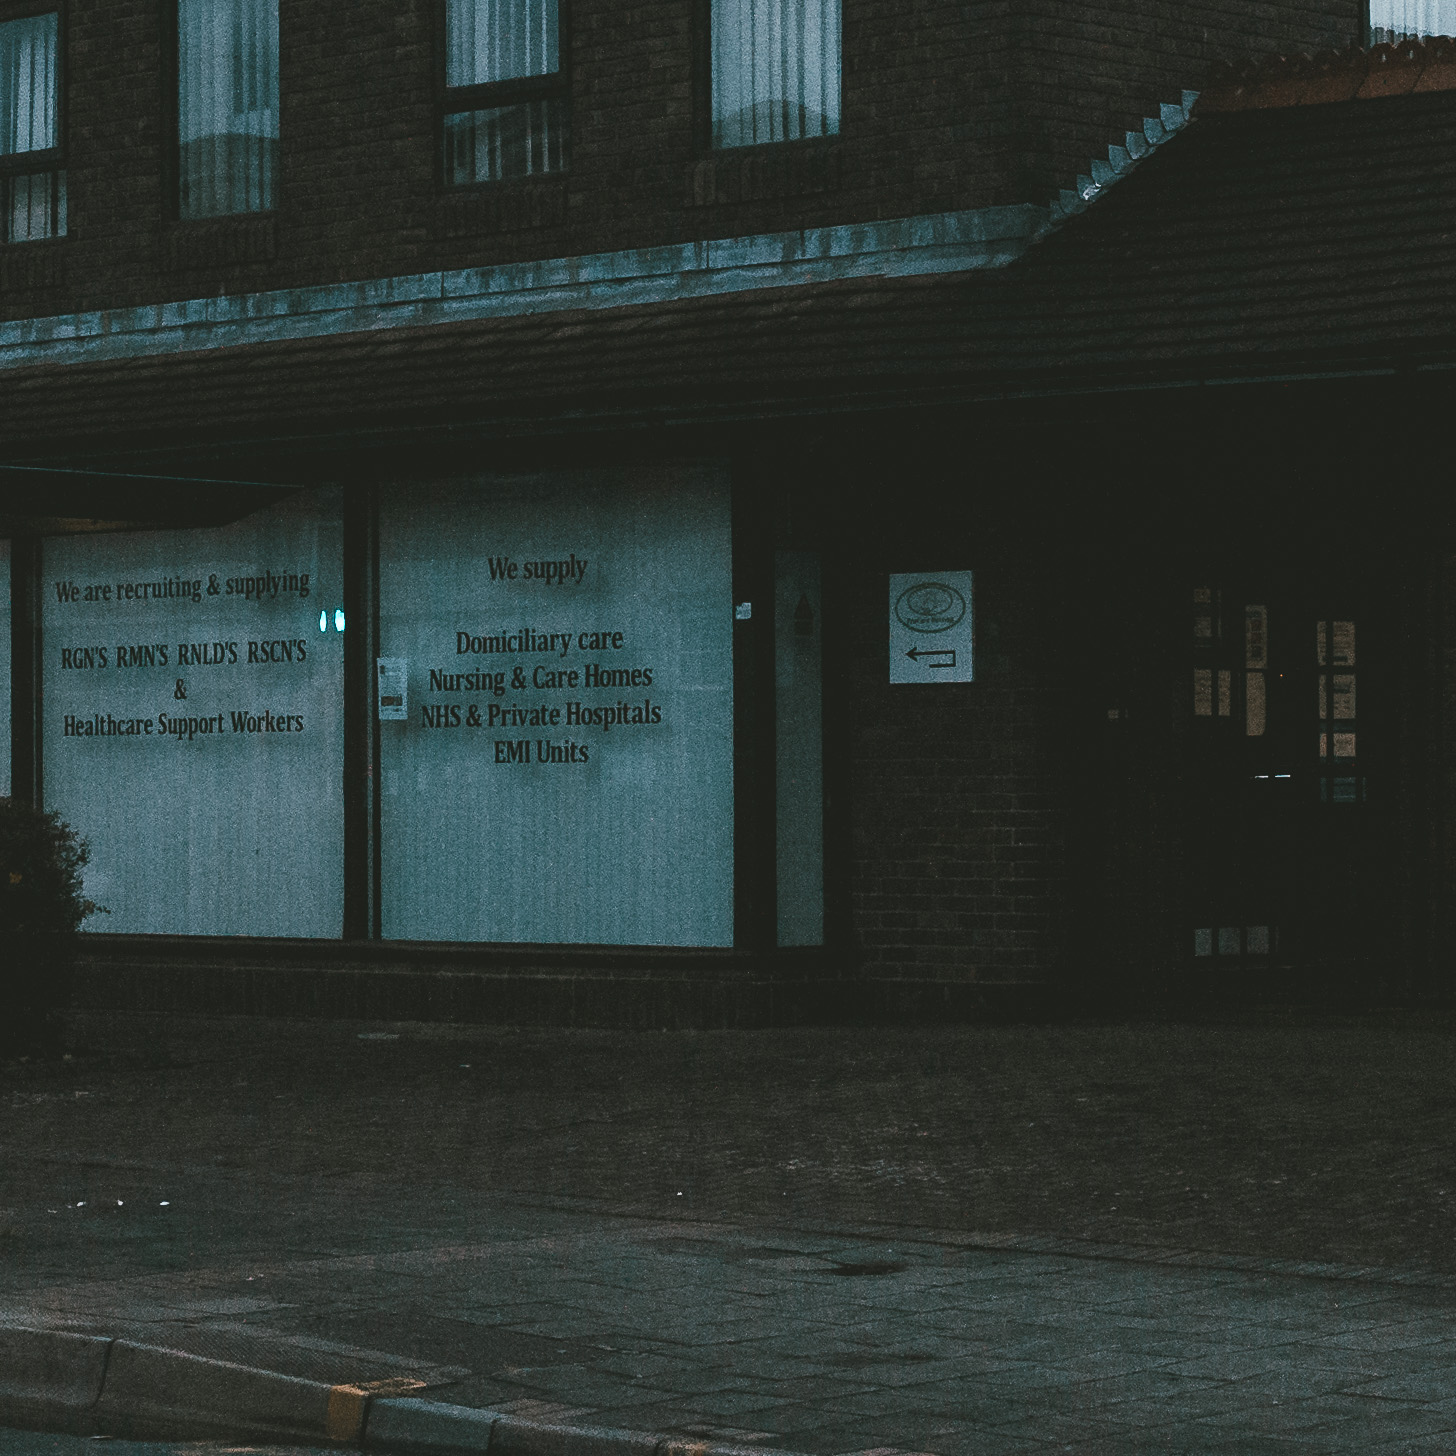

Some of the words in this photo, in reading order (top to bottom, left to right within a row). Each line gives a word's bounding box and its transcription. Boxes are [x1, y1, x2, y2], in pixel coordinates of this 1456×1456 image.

[487, 556, 518, 581] We
[523, 553, 588, 586] supply
[55, 580, 79, 603] We
[84, 584, 112, 602] are
[116, 575, 202, 603] recruiting
[206, 573, 221, 596] &
[225, 569, 310, 601] supplying
[61, 647, 108, 669] RGN'S
[116, 644, 169, 668] RMN'S
[177, 641, 238, 665] RNLD'S
[247, 639, 307, 663] RSCN'S
[456, 627, 572, 658] Domiciliary
[578, 630, 624, 651] care
[173, 678, 187, 700] &
[429, 667, 506, 696] Nursing
[510, 666, 527, 690] &
[533, 665, 579, 690] Care
[584, 663, 653, 688] Homes
[63, 713, 154, 736] Healthcare
[157, 712, 225, 741] Support
[231, 709, 304, 734] Workers
[421, 704, 461, 728] NHS
[465, 703, 482, 728] &
[487, 703, 561, 728] Private
[565, 699, 662, 732] Hospitals
[494, 740, 531, 764] EMI
[536, 739, 589, 764] Units
